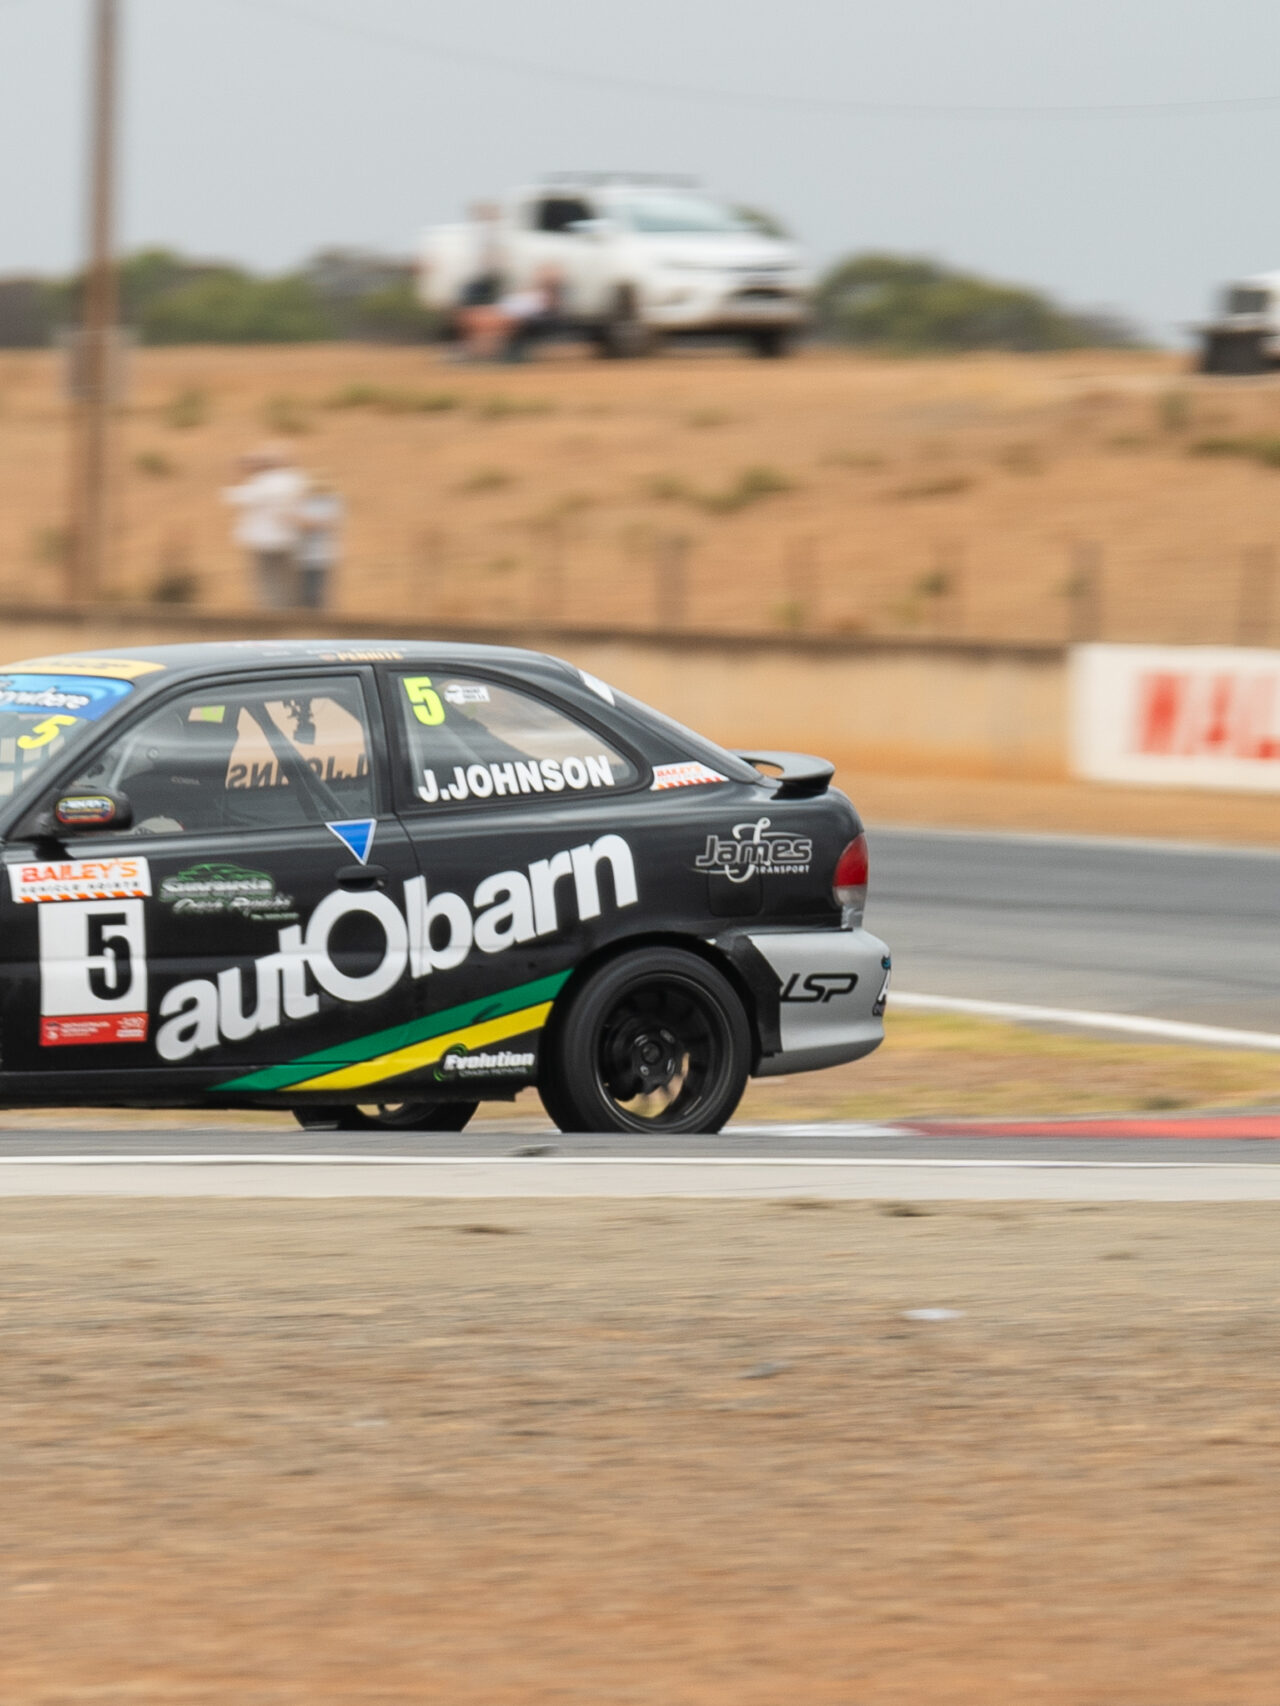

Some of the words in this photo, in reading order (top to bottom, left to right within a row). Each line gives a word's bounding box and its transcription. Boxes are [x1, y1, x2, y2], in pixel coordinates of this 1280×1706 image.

[403, 677, 446, 726] 5
[17, 714, 77, 750] 5
[418, 755, 615, 803] J.JOHNSON
[695, 834, 812, 867] James
[21, 857, 139, 883] BAILEY'S
[755, 864, 810, 875] TRANSPORT
[86, 912, 133, 1001] 5
[779, 973, 858, 1004] LSP
[443, 1051, 535, 1071] Evolution
